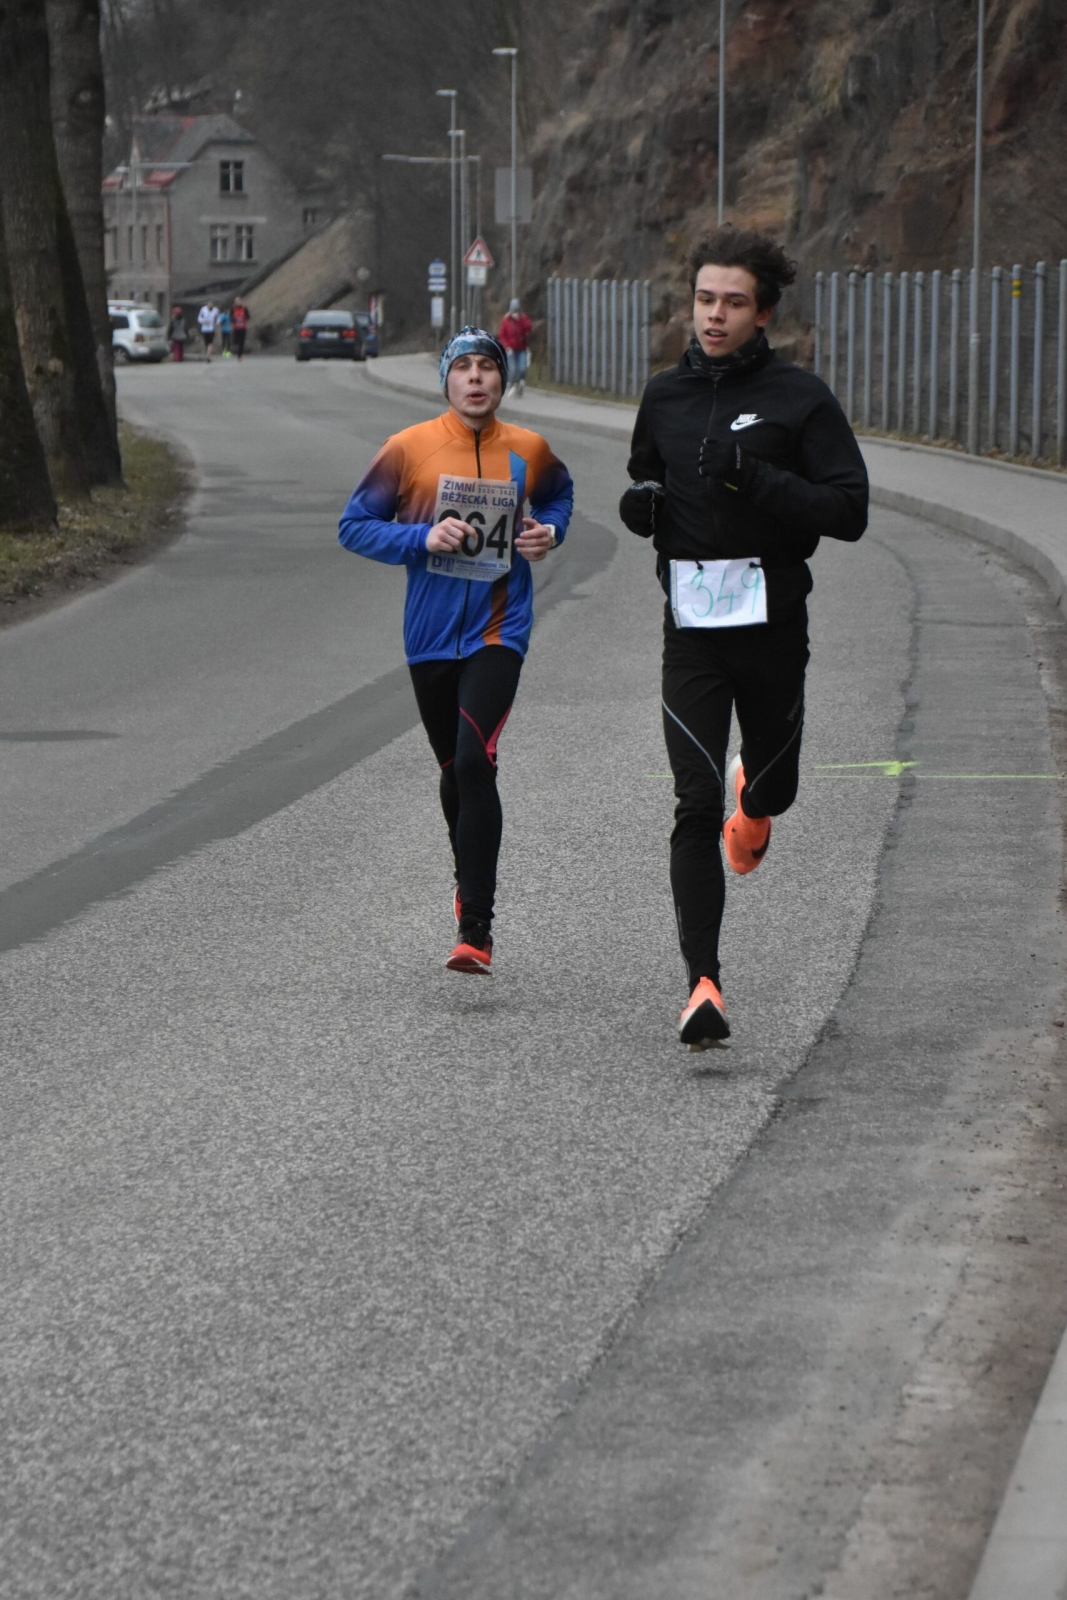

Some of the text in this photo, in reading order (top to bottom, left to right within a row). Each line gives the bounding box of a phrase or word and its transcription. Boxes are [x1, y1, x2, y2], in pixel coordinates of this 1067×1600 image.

[443, 480, 476, 493] ZIMNÍ
[441, 491, 488, 506] BĚŽECKÁ
[492, 496, 515, 508] LIGA
[690, 567, 760, 618] 349
